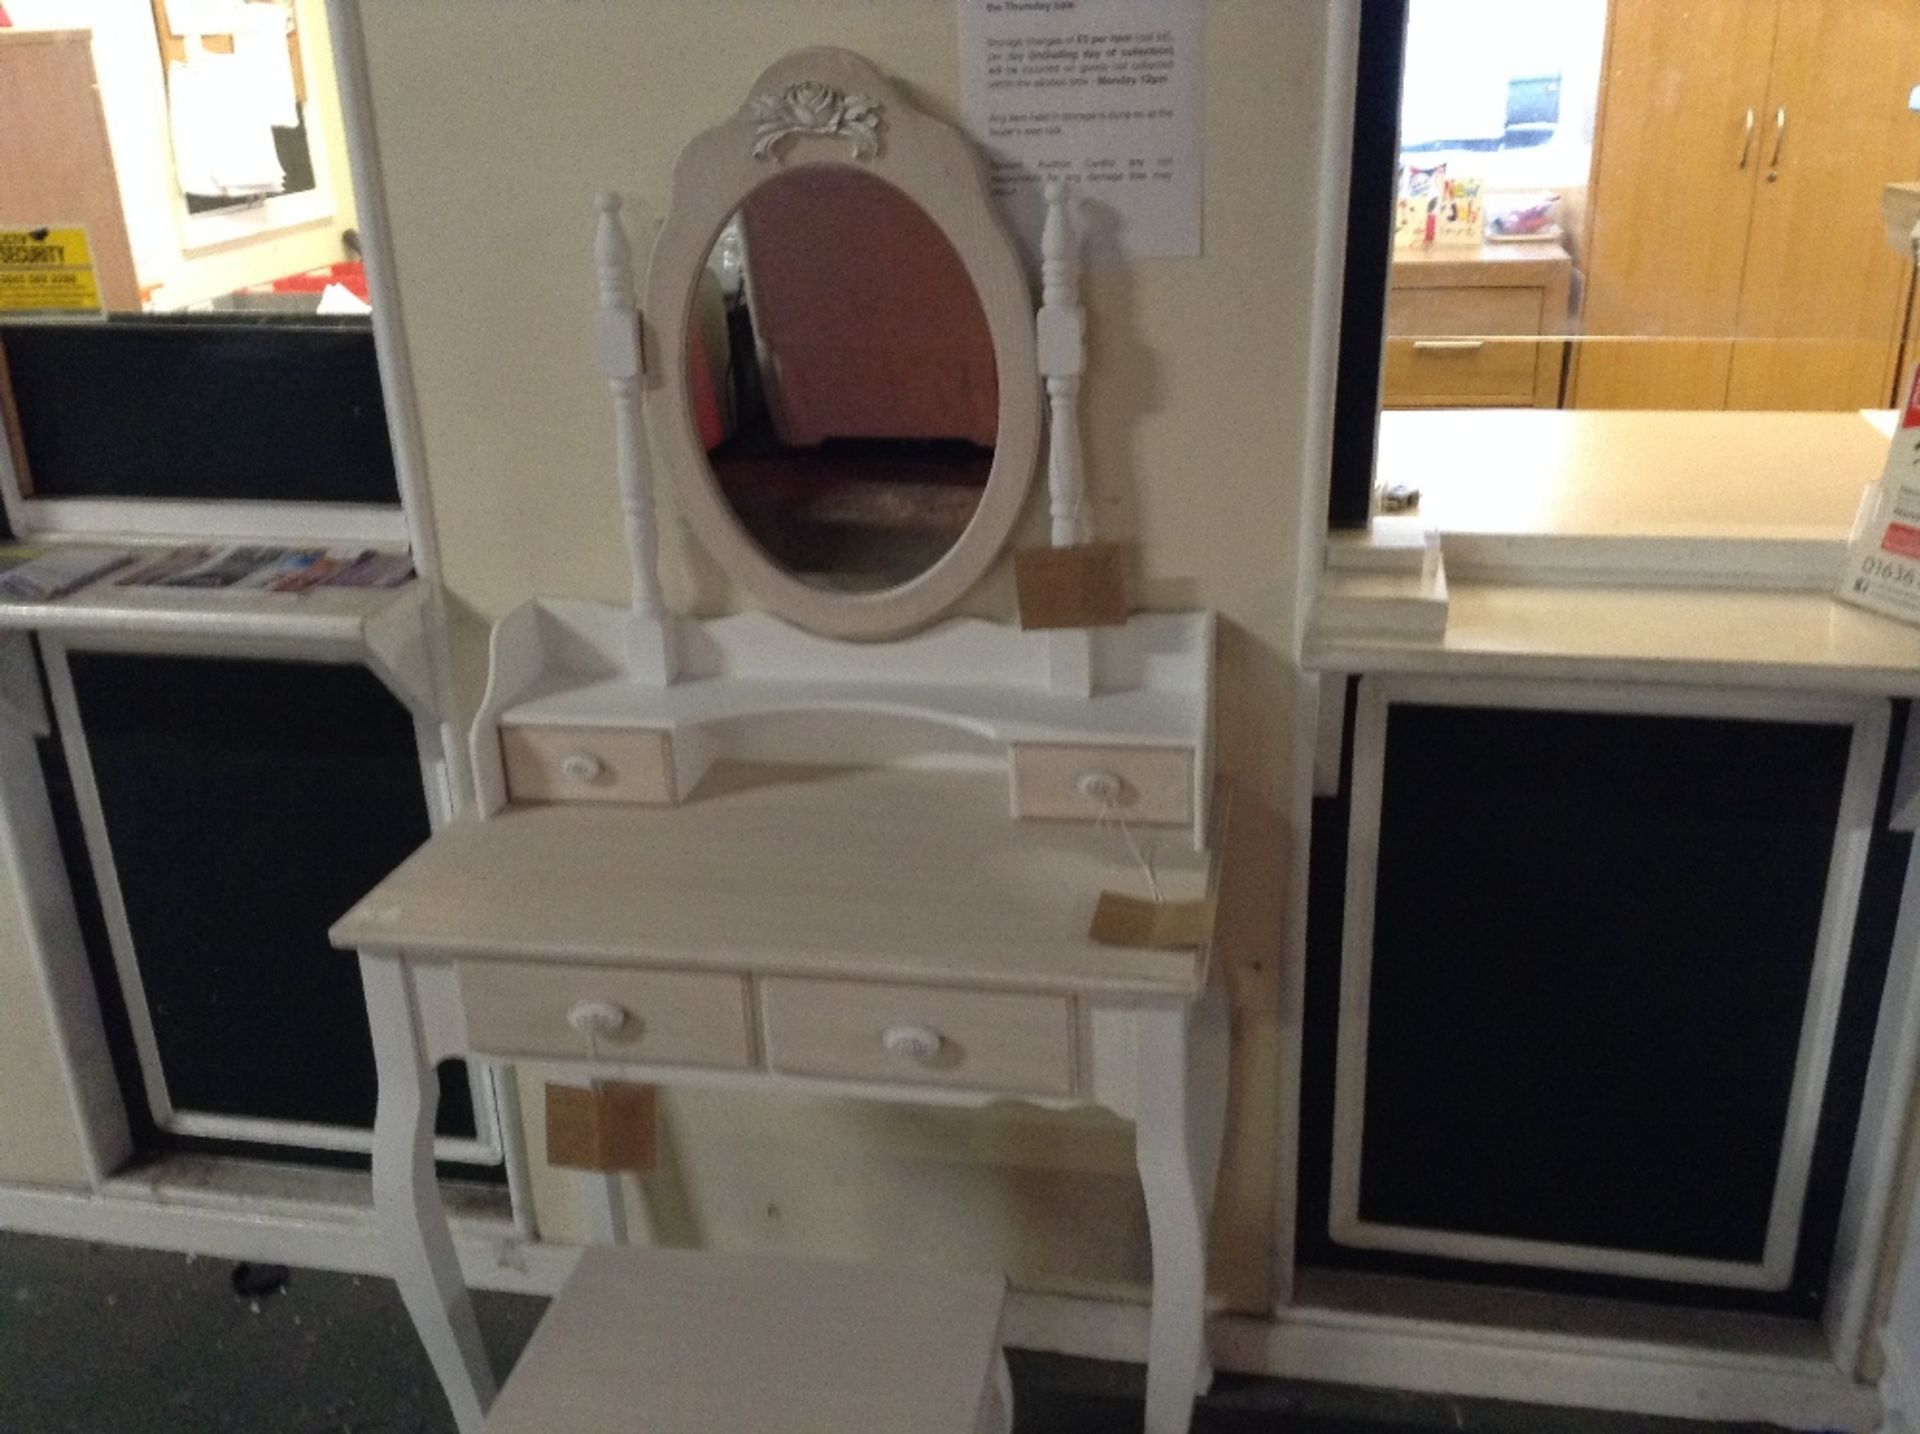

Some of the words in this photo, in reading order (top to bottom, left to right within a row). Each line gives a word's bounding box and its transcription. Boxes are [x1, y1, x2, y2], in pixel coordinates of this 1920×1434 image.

[1005, 1, 1052, 12] Thursday
[1096, 75, 1136, 86] Monday
[1443, 178, 1480, 199] New
[1862, 556, 1915, 585] 01636
